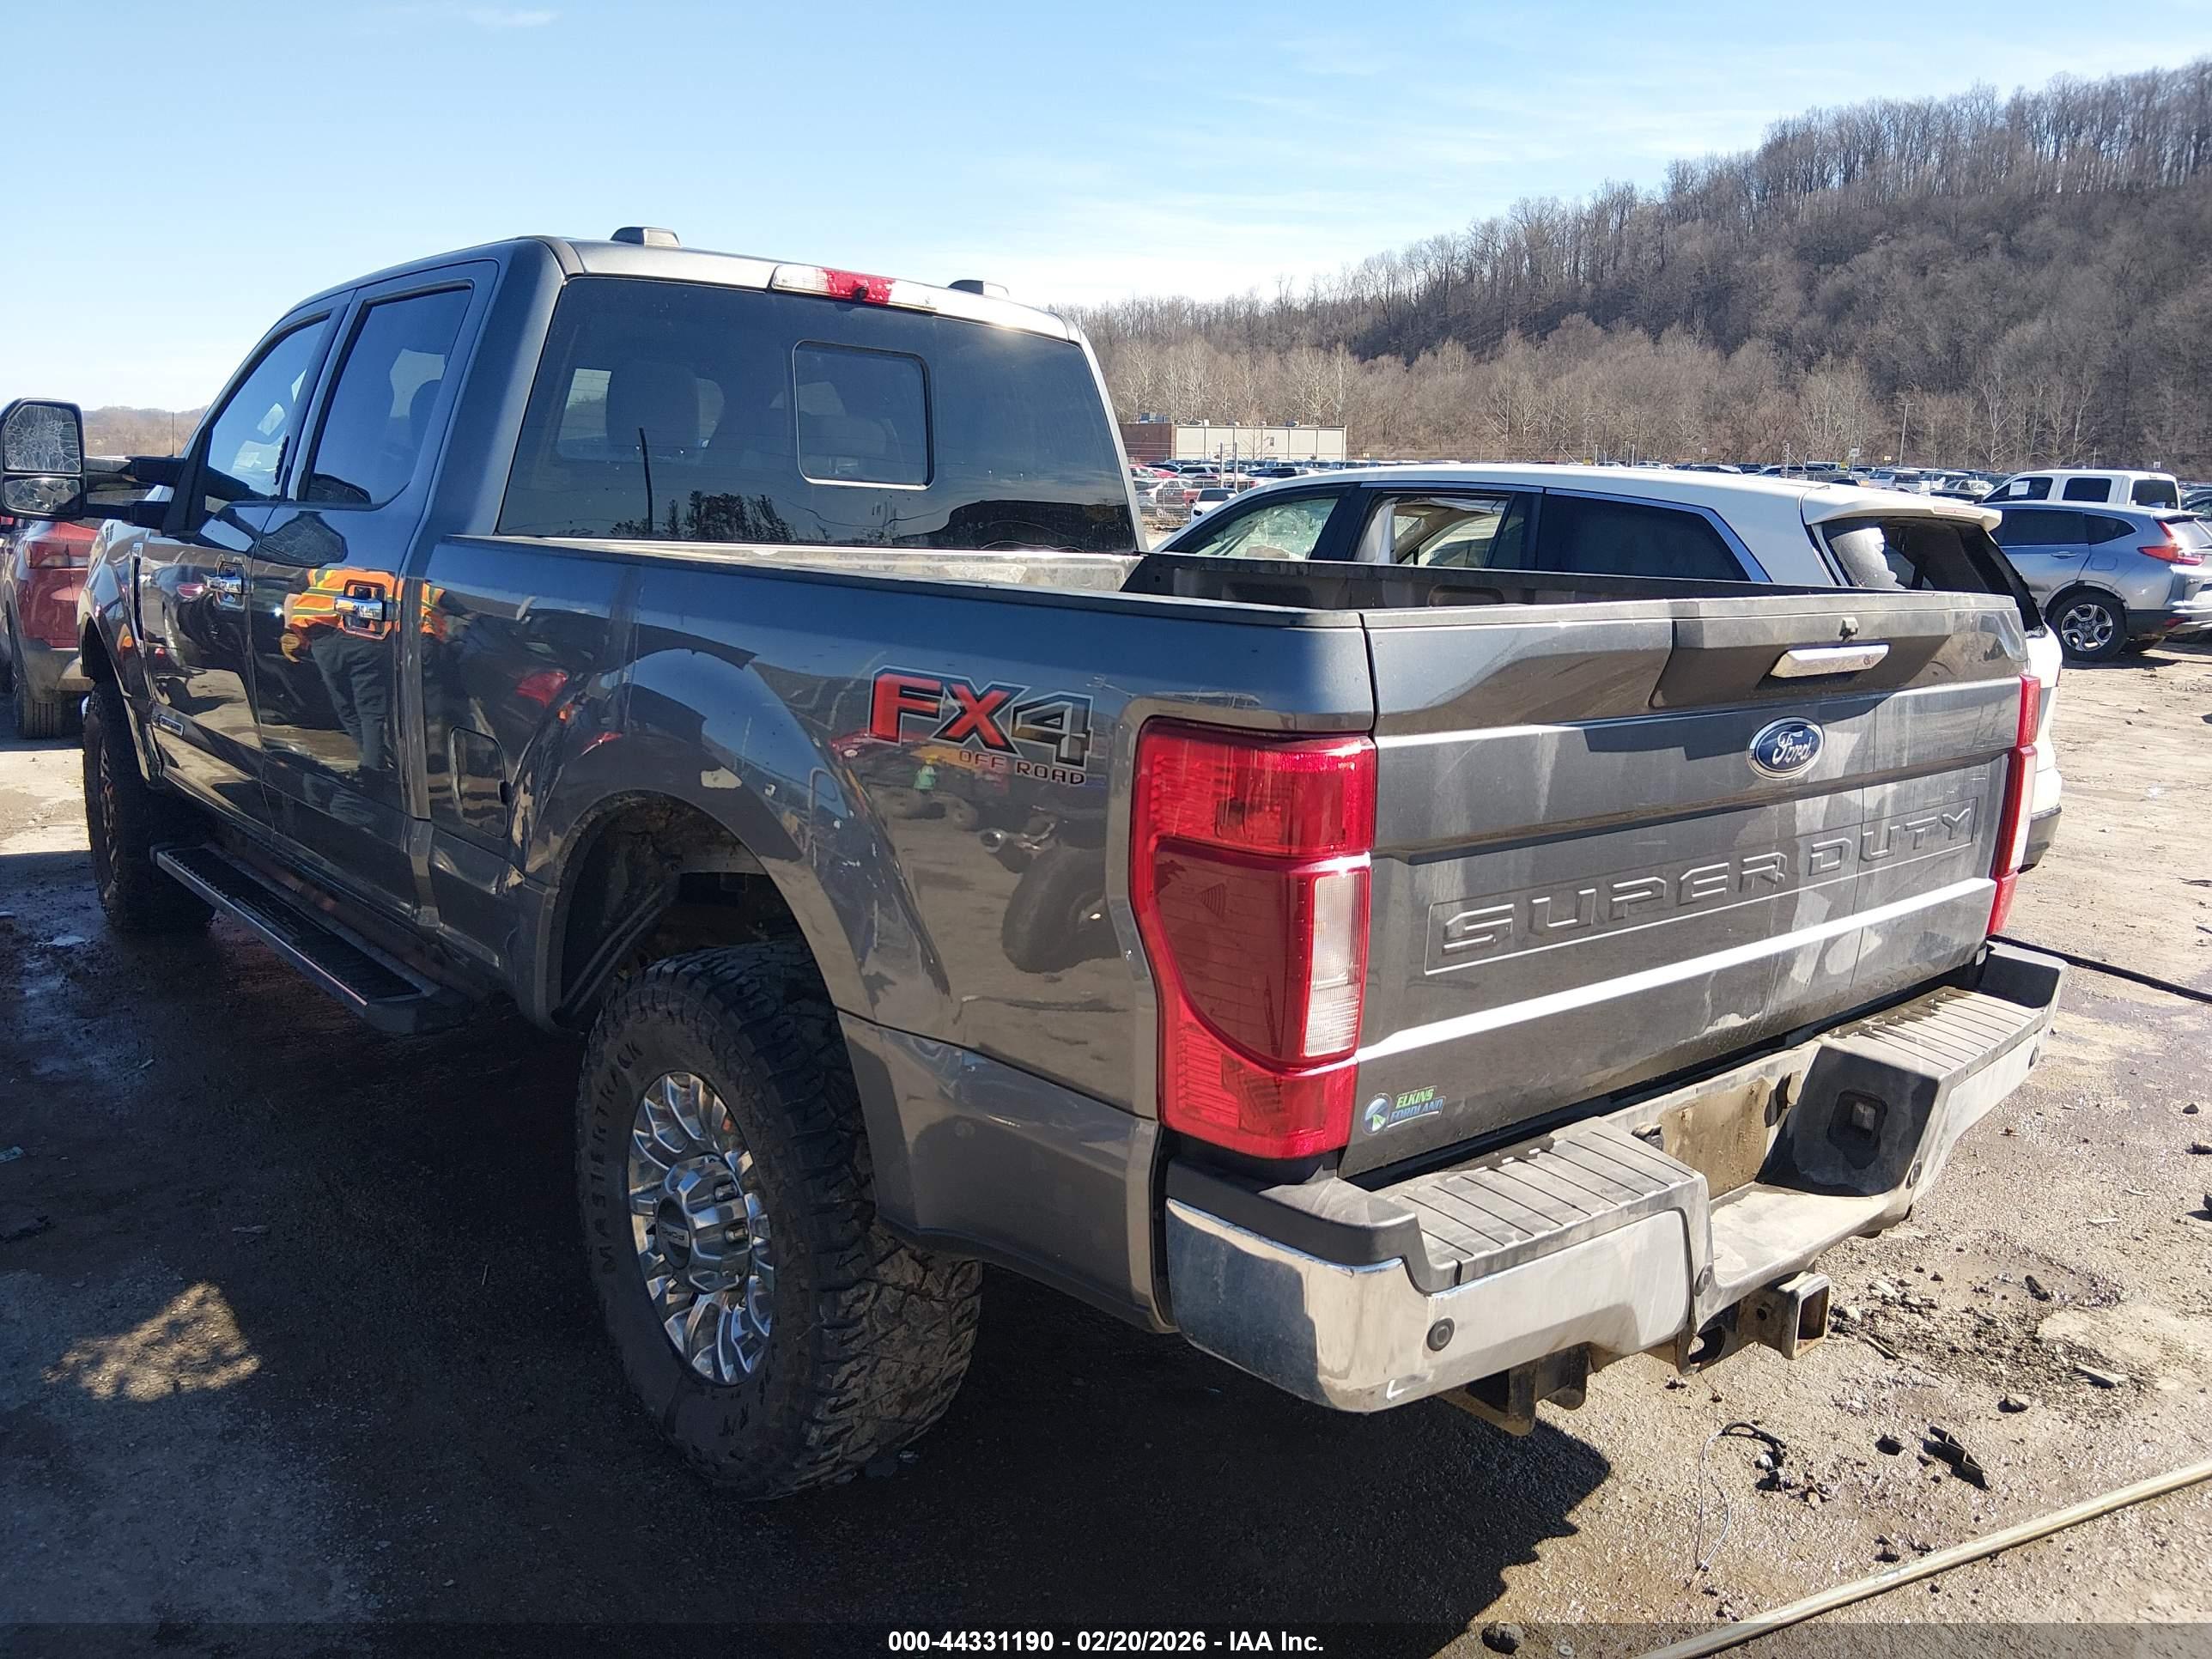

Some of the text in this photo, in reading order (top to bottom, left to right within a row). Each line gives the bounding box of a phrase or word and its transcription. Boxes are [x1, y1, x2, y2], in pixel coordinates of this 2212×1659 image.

[868, 665, 1094, 771] FX4
[1771, 730, 1813, 765] Ford
[958, 750, 1086, 785] OFF ROAD
[1443, 806, 1972, 955] SUPER DUTY
[1395, 1087, 1436, 1109] ELKINS
